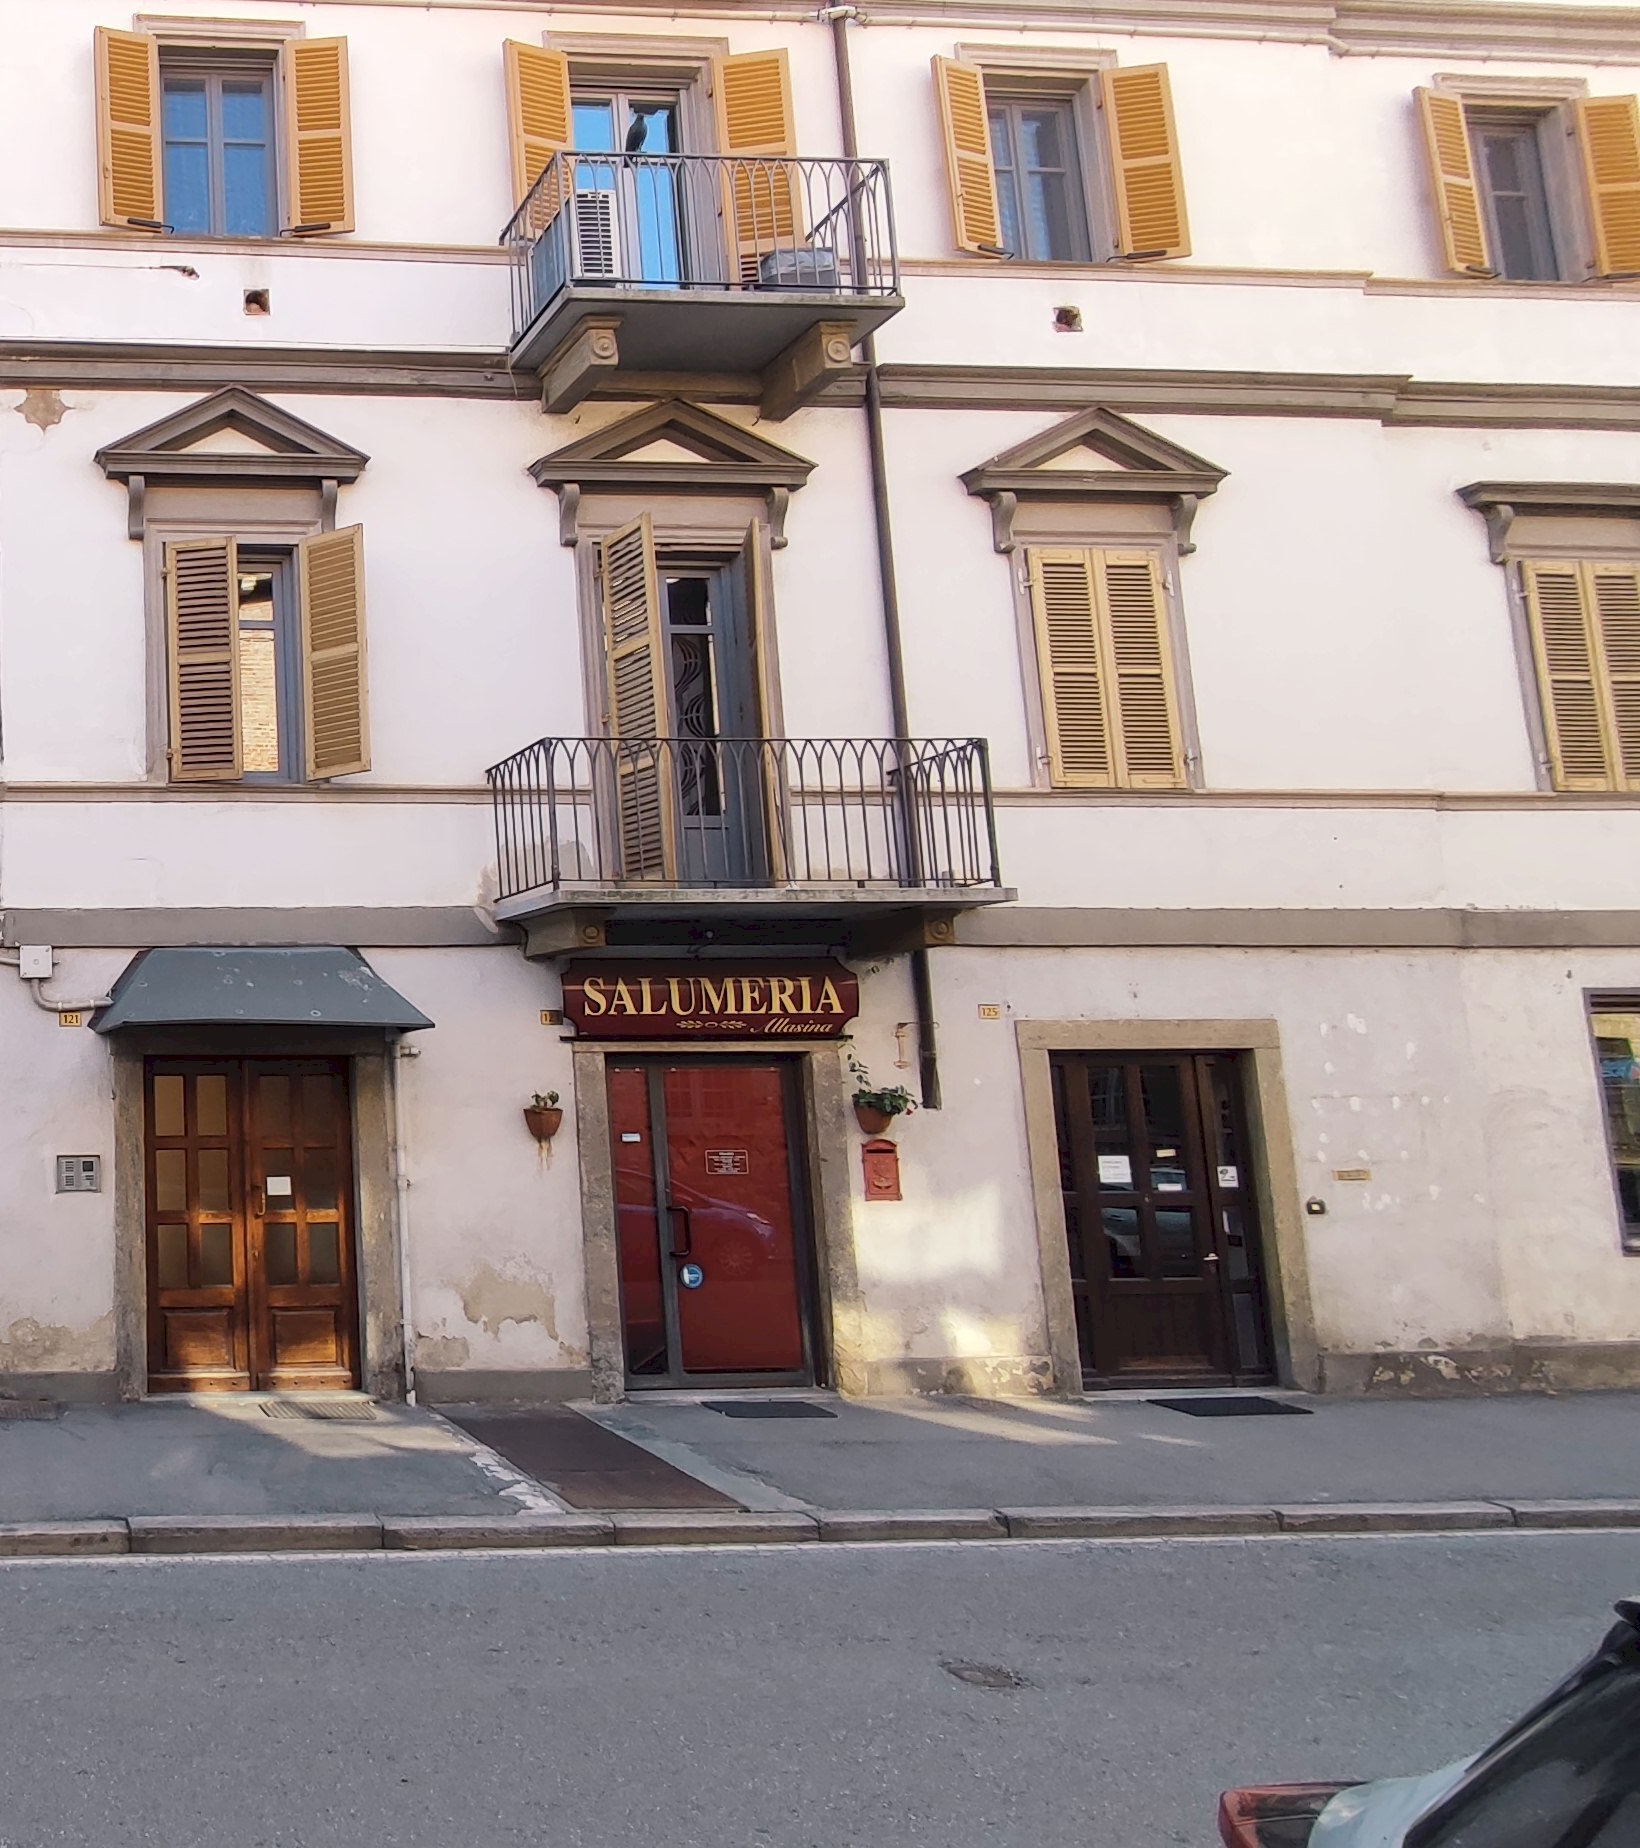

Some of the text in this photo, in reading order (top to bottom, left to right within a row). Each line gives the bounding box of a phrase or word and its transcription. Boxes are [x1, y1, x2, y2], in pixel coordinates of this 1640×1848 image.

[583, 975, 845, 1016] SALUMERIA
[981, 1007, 998, 1017] 125
[63, 1014, 79, 1024] 121
[749, 1017, 834, 1034] Allasina
